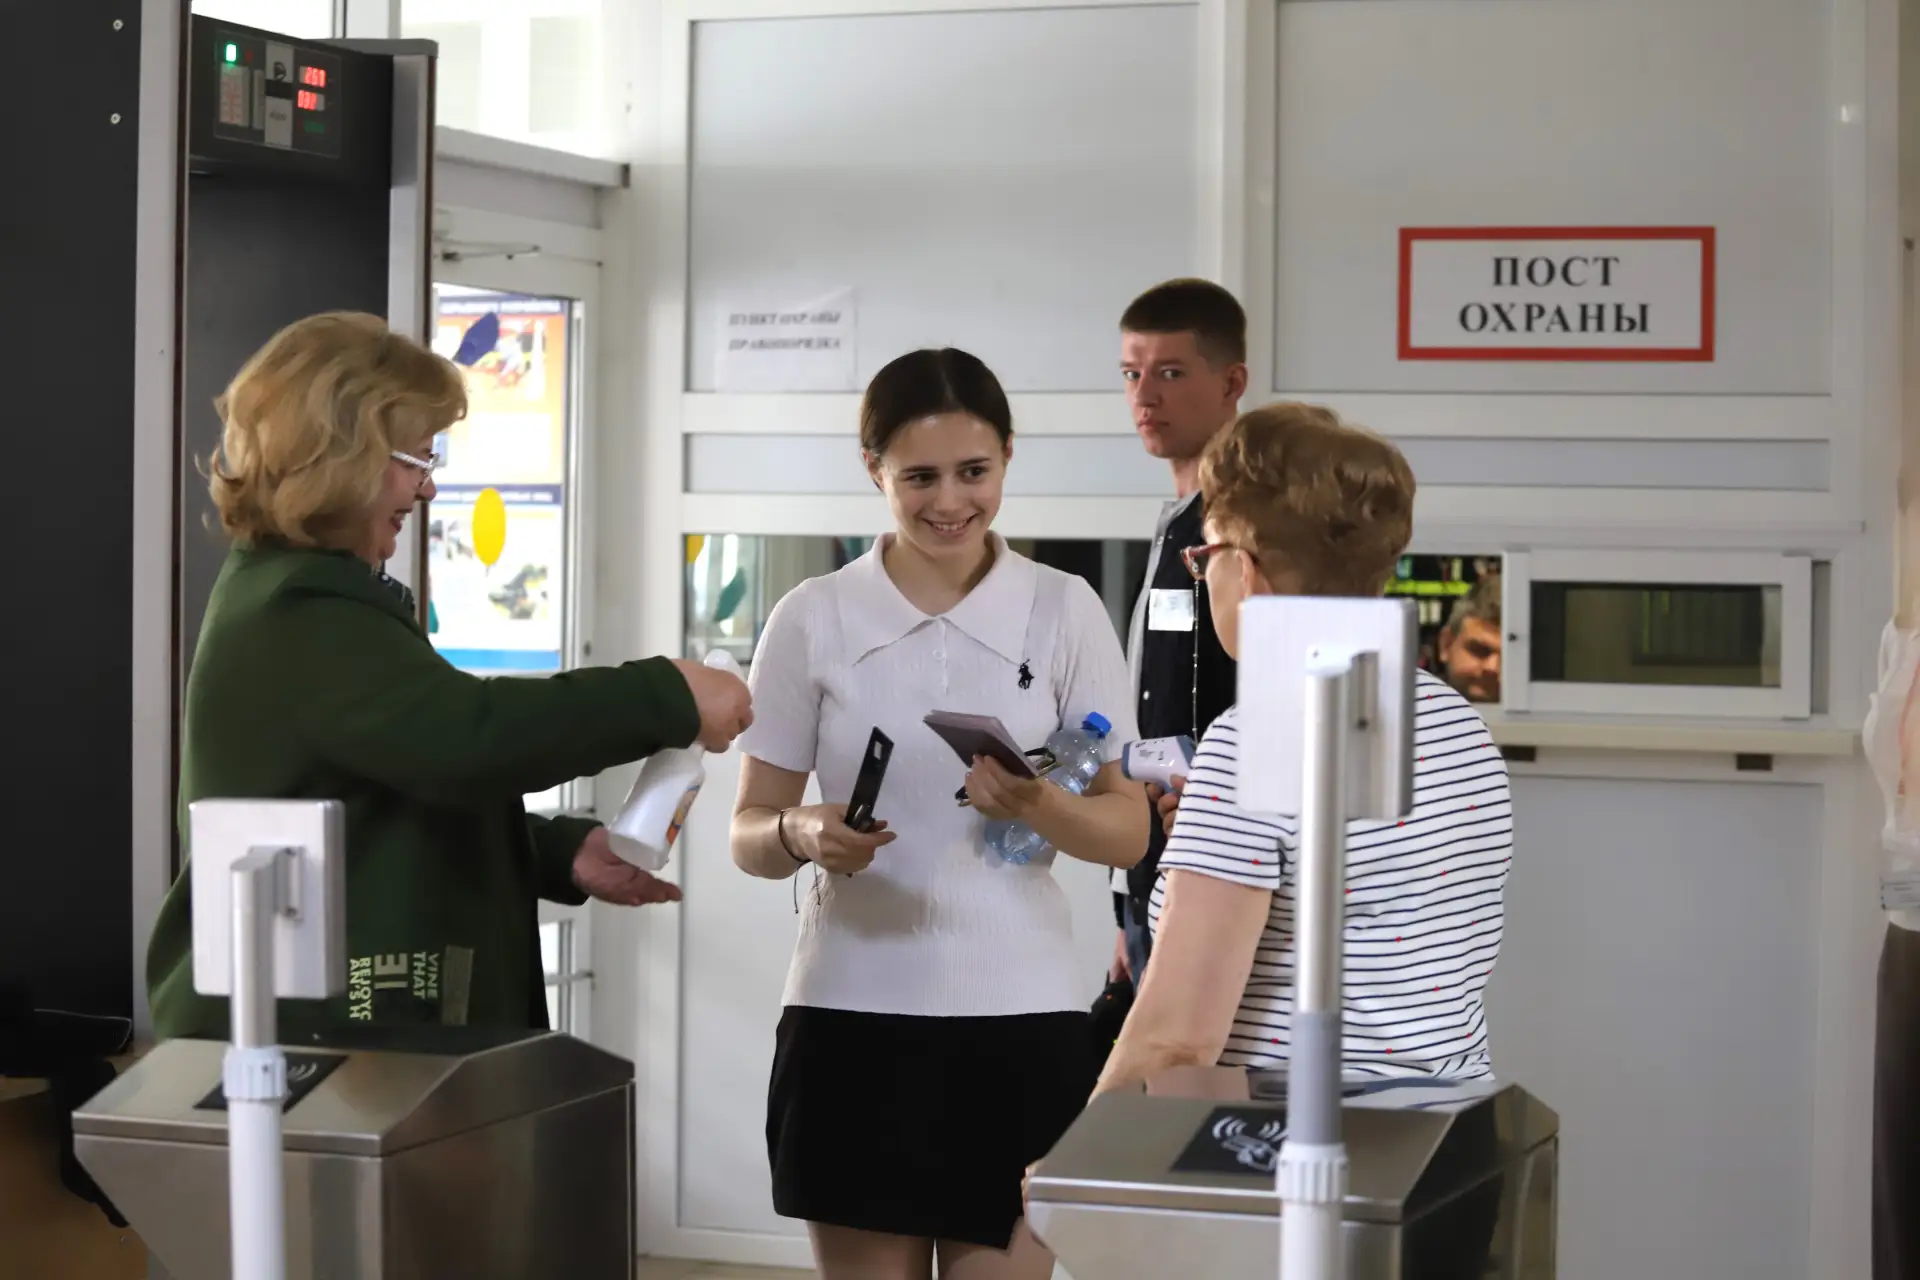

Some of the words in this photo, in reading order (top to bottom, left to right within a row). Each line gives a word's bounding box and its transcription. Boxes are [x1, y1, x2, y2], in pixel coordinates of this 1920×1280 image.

[1492, 256, 1620, 287] ПОСТ
[1459, 302, 1650, 333] ОХРАНЫ
[413, 952, 426, 999] THAT
